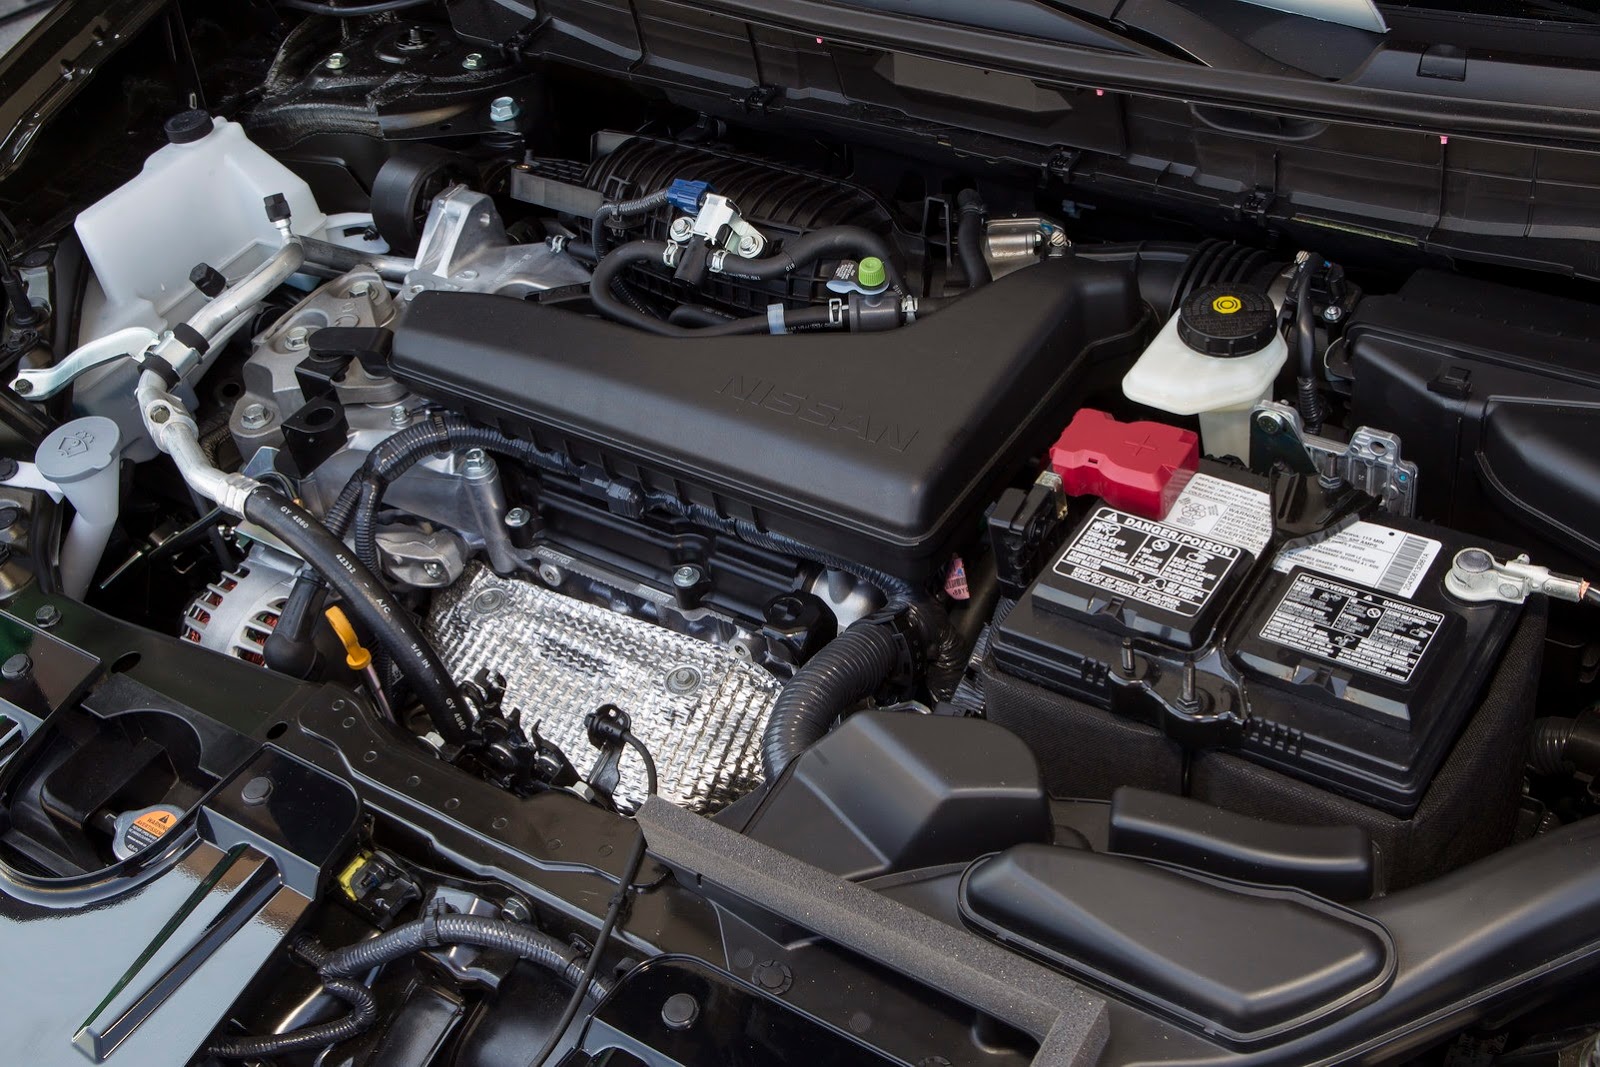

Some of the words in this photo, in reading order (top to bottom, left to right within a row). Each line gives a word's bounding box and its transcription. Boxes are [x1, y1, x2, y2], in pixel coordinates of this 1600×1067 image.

[714, 376, 920, 452] NISSAN
[280, 506, 292, 515] GY
[1222, 515, 1270, 532] AVERTISSEME
[1108, 536, 1126, 545] EYES
[1123, 517, 1233, 556] DANGER/POISON
[1137, 558, 1159, 567] FLAMES
[1168, 561, 1186, 570] ACID
[1172, 556, 1206, 570] SULFURIC
[1073, 567, 1091, 576] KEEP
[1299, 576, 1358, 596] PELIGRO/VENENO
[1382, 600, 1441, 621] DANGER/POISON
[335, 554, 357, 574] 42332
[376, 598, 391, 614] A/C
[410, 643, 423, 658] 5/8
[421, 659, 431, 669] IN
[445, 697, 456, 709] GY
